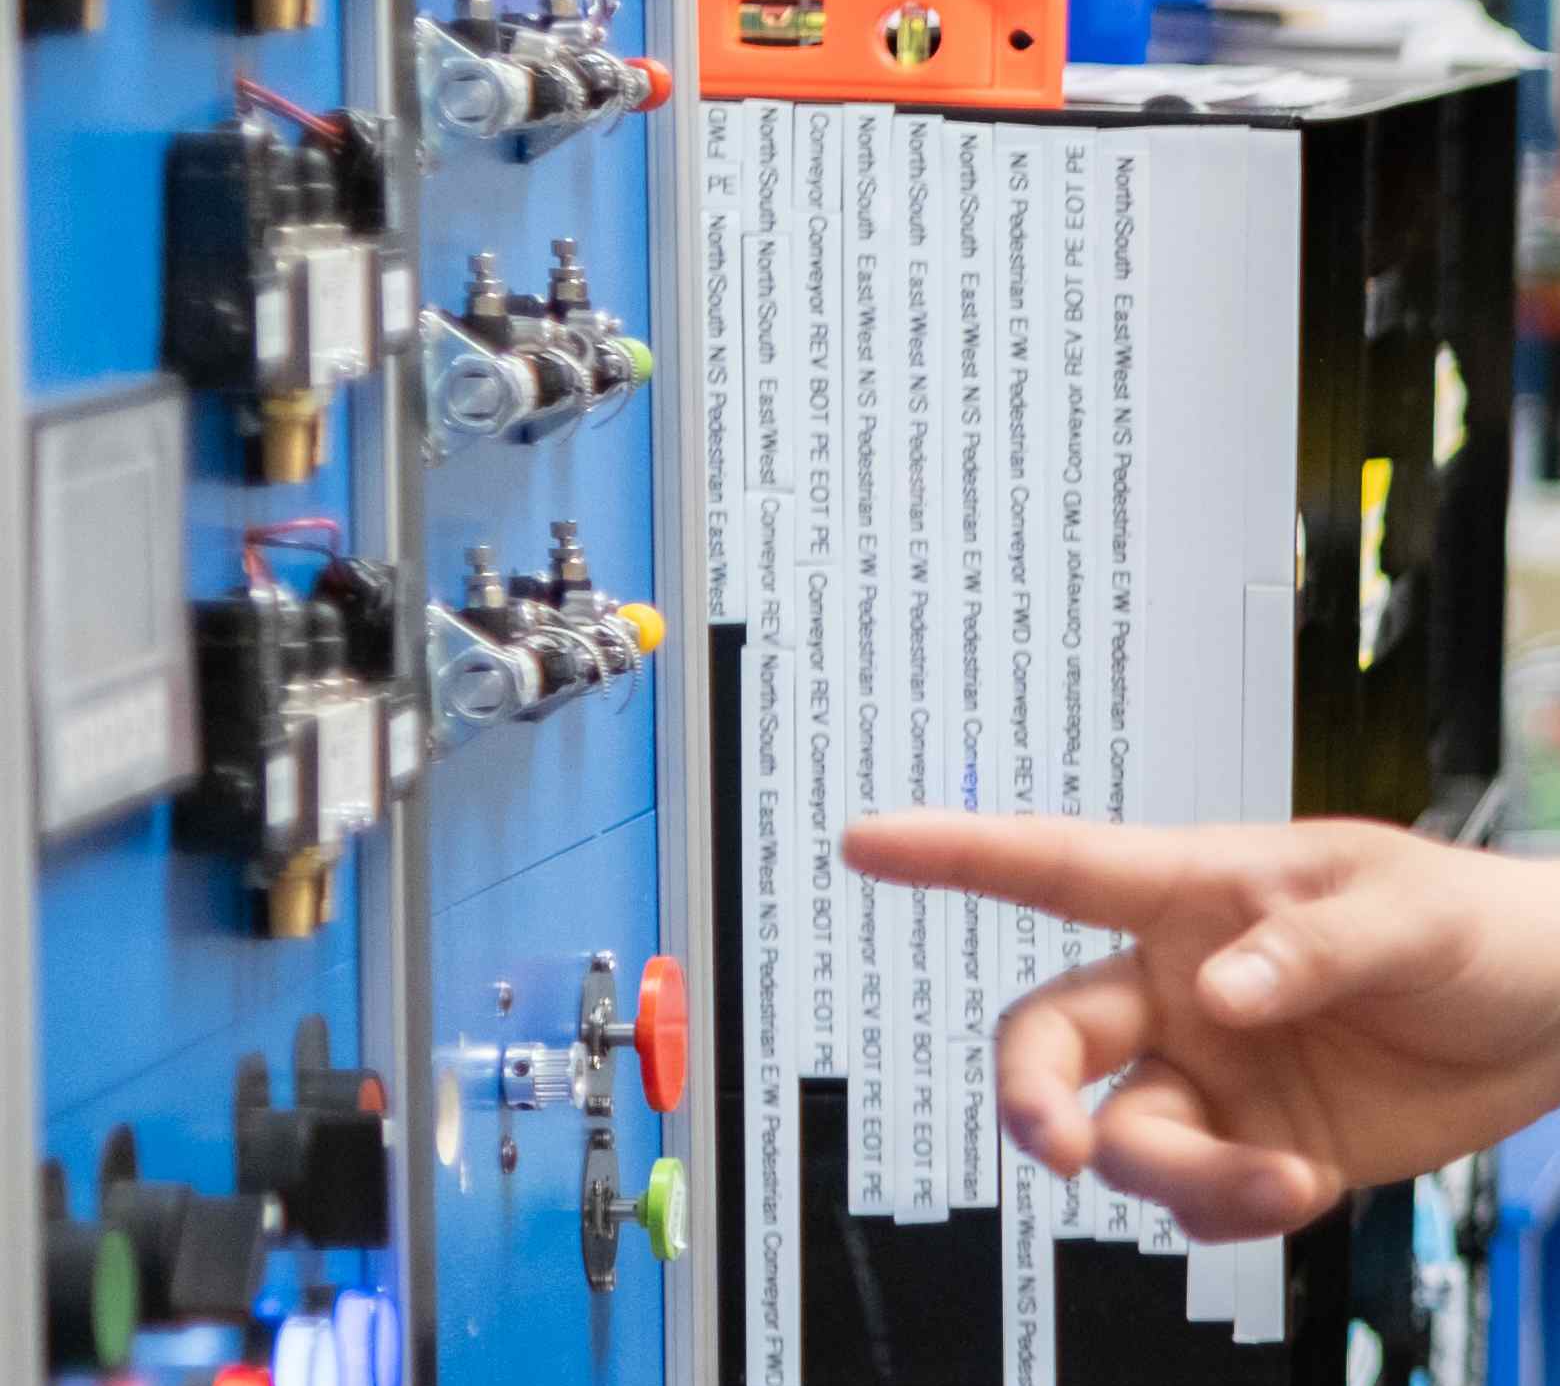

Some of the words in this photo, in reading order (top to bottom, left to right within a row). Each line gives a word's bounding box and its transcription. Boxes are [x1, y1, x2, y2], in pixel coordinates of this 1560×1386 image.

[757, 105, 780, 233] North/South
[805, 111, 831, 211] Conveyor
[856, 114, 878, 241] North/South
[907, 120, 929, 247] North/South
[1007, 151, 1030, 192] N/S
[1064, 145, 1086, 175] PE
[958, 132, 981, 260] North/South
[1064, 180, 1086, 231] EOT
[1113, 156, 1136, 281] North/South
[706, 213, 729, 339] North/South
[805, 214, 829, 318] Conveyor
[1007, 197, 1030, 311] Pedestrian
[1063, 237, 1086, 268] PE
[756, 239, 779, 365] North/South
[856, 252, 878, 362] East/West
[907, 259, 929, 369] East/West
[959, 270, 981, 380] East/West
[1063, 273, 1085, 323] BOT
[706, 343, 729, 386] N/S
[808, 321, 830, 371] REV
[1008, 315, 1030, 362] E/W
[1063, 328, 1085, 377] REV
[1112, 292, 1135, 402] East/West
[808, 376, 831, 426] BOT
[856, 368, 879, 409] N/S
[907, 373, 929, 414] N/S
[960, 384, 983, 426] N/S
[706, 390, 729, 504] Pedestrian
[757, 377, 779, 487] East/West
[809, 431, 831, 463] PE
[1008, 367, 1029, 480] Pedestrian
[1061, 382, 1087, 485] Conveyor
[1111, 406, 1134, 447] N/S
[808, 468, 831, 519] EOT
[856, 413, 878, 528] Pedestrian
[908, 419, 929, 533] Pedestrian
[961, 430, 982, 544] Pedestrian
[1007, 483, 1031, 584] Conveyor
[1061, 489, 1083, 543] FWD
[1111, 451, 1133, 565] Pedestrian
[707, 509, 729, 618] East/West
[757, 497, 782, 594] Conveyor
[809, 524, 831, 556] PE
[857, 532, 879, 578] E/W
[908, 538, 930, 584] E/W
[962, 548, 983, 595] E/W
[1111, 569, 1132, 616] E/W
[760, 599, 782, 647] REV
[805, 570, 829, 673] Conveyor
[1011, 590, 1032, 645] FWD
[1061, 548, 1086, 650] Conveyor
[857, 583, 879, 698] Pedestrian
[908, 588, 930, 703] Pedestrian
[962, 599, 983, 713] Pedestrian
[809, 678, 831, 727] REV
[1009, 649, 1033, 750] Conveyor
[1109, 619, 1132, 732] Pedestrian
[758, 652, 780, 777] North/South
[1061, 654, 1083, 768] Pedestrian
[855, 701, 880, 804] Conveyor
[959, 717, 984, 812] Conveyo
[1013, 754, 1035, 804] REV
[807, 731, 831, 835] Conveyor
[757, 788, 780, 897] East/West
[811, 838, 833, 892] FWD
[757, 902, 780, 942] N/S
[811, 896, 833, 945] BOT
[812, 950, 833, 982] PE
[1016, 953, 1037, 986] PE
[759, 946, 780, 1059] Pedestrian
[812, 987, 835, 1036] EOT
[861, 972, 882, 1021] REV
[911, 977, 933, 1027] REV
[963, 987, 985, 1036] REV
[813, 1041, 835, 1075] PE
[861, 1025, 883, 1074] BOT
[911, 1031, 933, 1079] BOT
[963, 1046, 985, 1086] N/S
[760, 1063, 781, 1109] E/W
[861, 1078, 883, 1111] PE
[912, 1084, 933, 1116] PE
[861, 1116, 884, 1165] EOT
[912, 1121, 934, 1174] EOT
[962, 1089, 985, 1202] Pedestrian
[760, 1113, 783, 1226] Pedestrian
[862, 1170, 883, 1203] PE
[912, 1177, 934, 1209] PE
[1015, 1161, 1037, 1271] East/West
[760, 1230, 784, 1334] Conveyor
[1016, 1275, 1038, 1316] N/S
